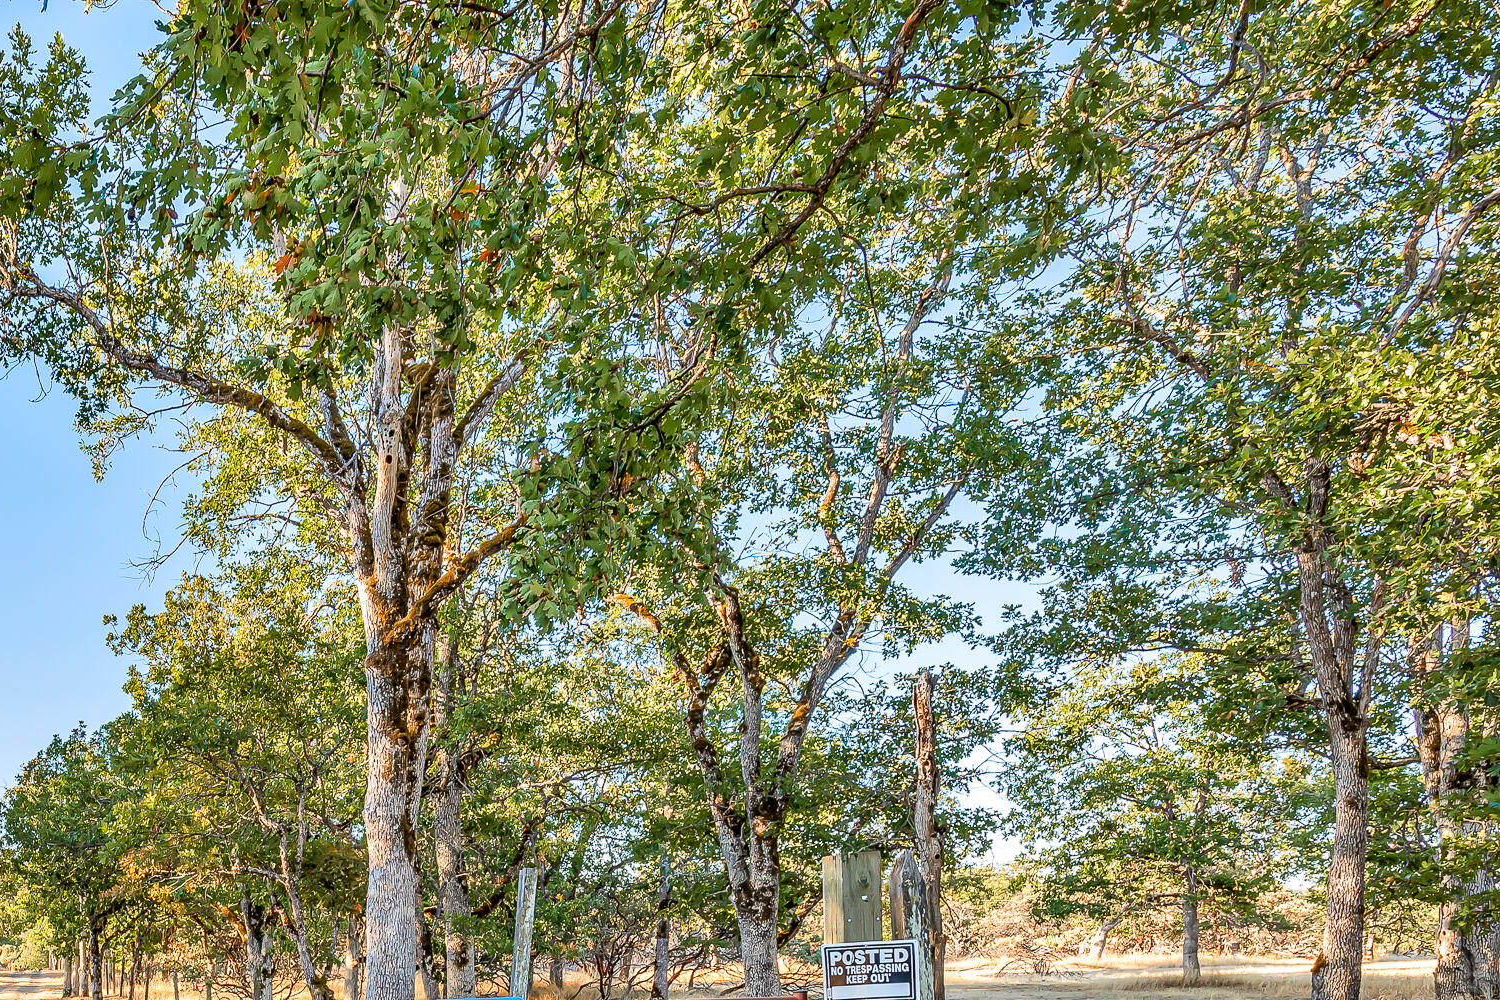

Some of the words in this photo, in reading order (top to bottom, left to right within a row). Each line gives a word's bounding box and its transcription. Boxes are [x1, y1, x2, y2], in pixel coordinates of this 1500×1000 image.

[830, 948, 908, 966] POSTED
[831, 966, 843, 976] NO
[846, 963, 909, 975] TRESPASSING
[846, 974, 868, 984] KEEP
[870, 973, 891, 982] OUT
